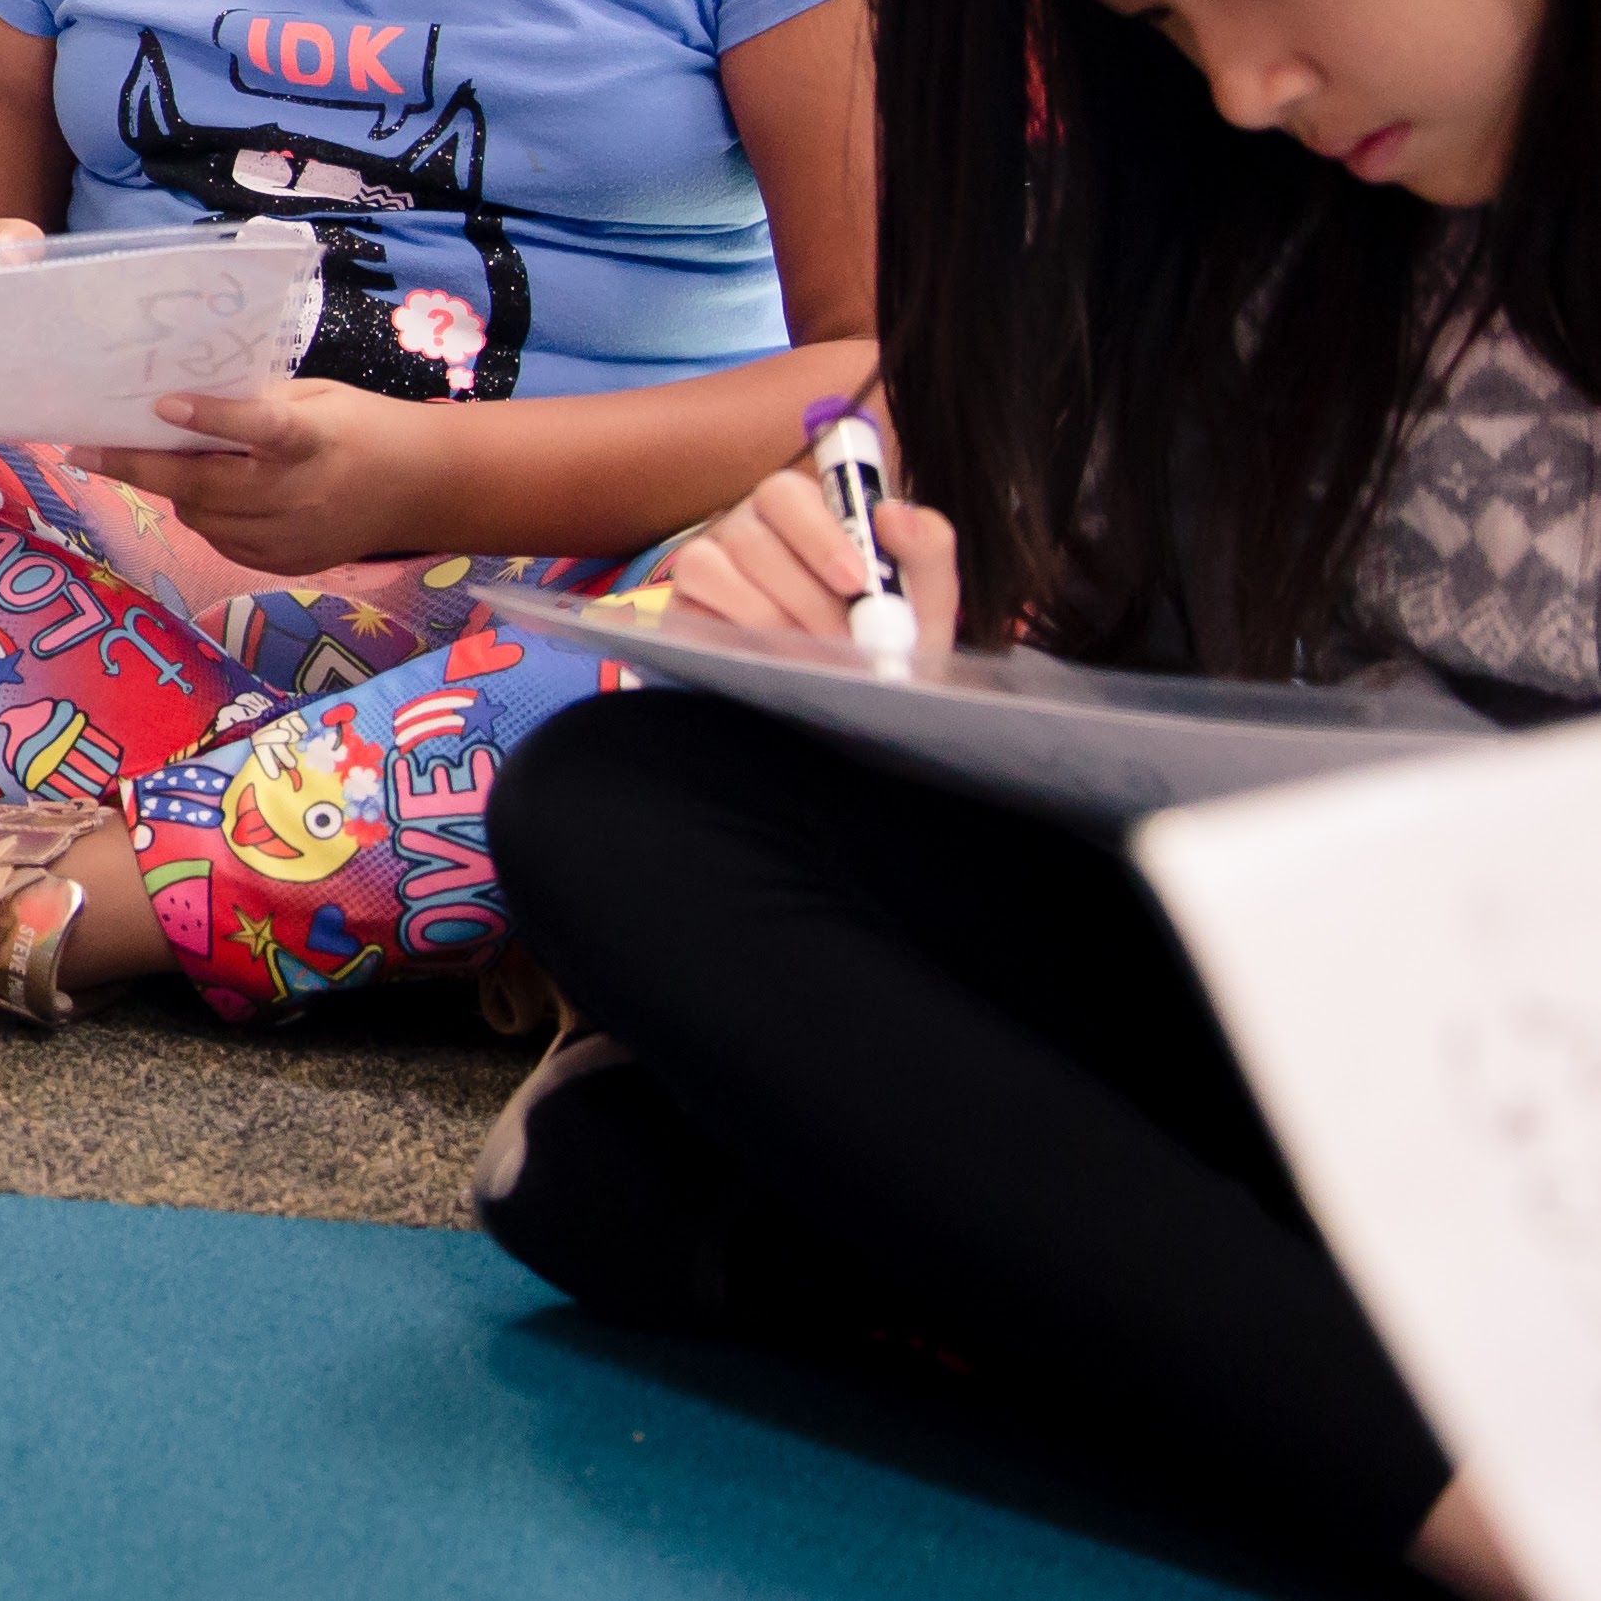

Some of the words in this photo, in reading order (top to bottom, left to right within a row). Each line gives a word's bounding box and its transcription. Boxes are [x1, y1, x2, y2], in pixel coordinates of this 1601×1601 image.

[247, 17, 406, 95] IDK
[386, 742, 509, 956] OVE
[9, 924, 35, 976] STEVE
